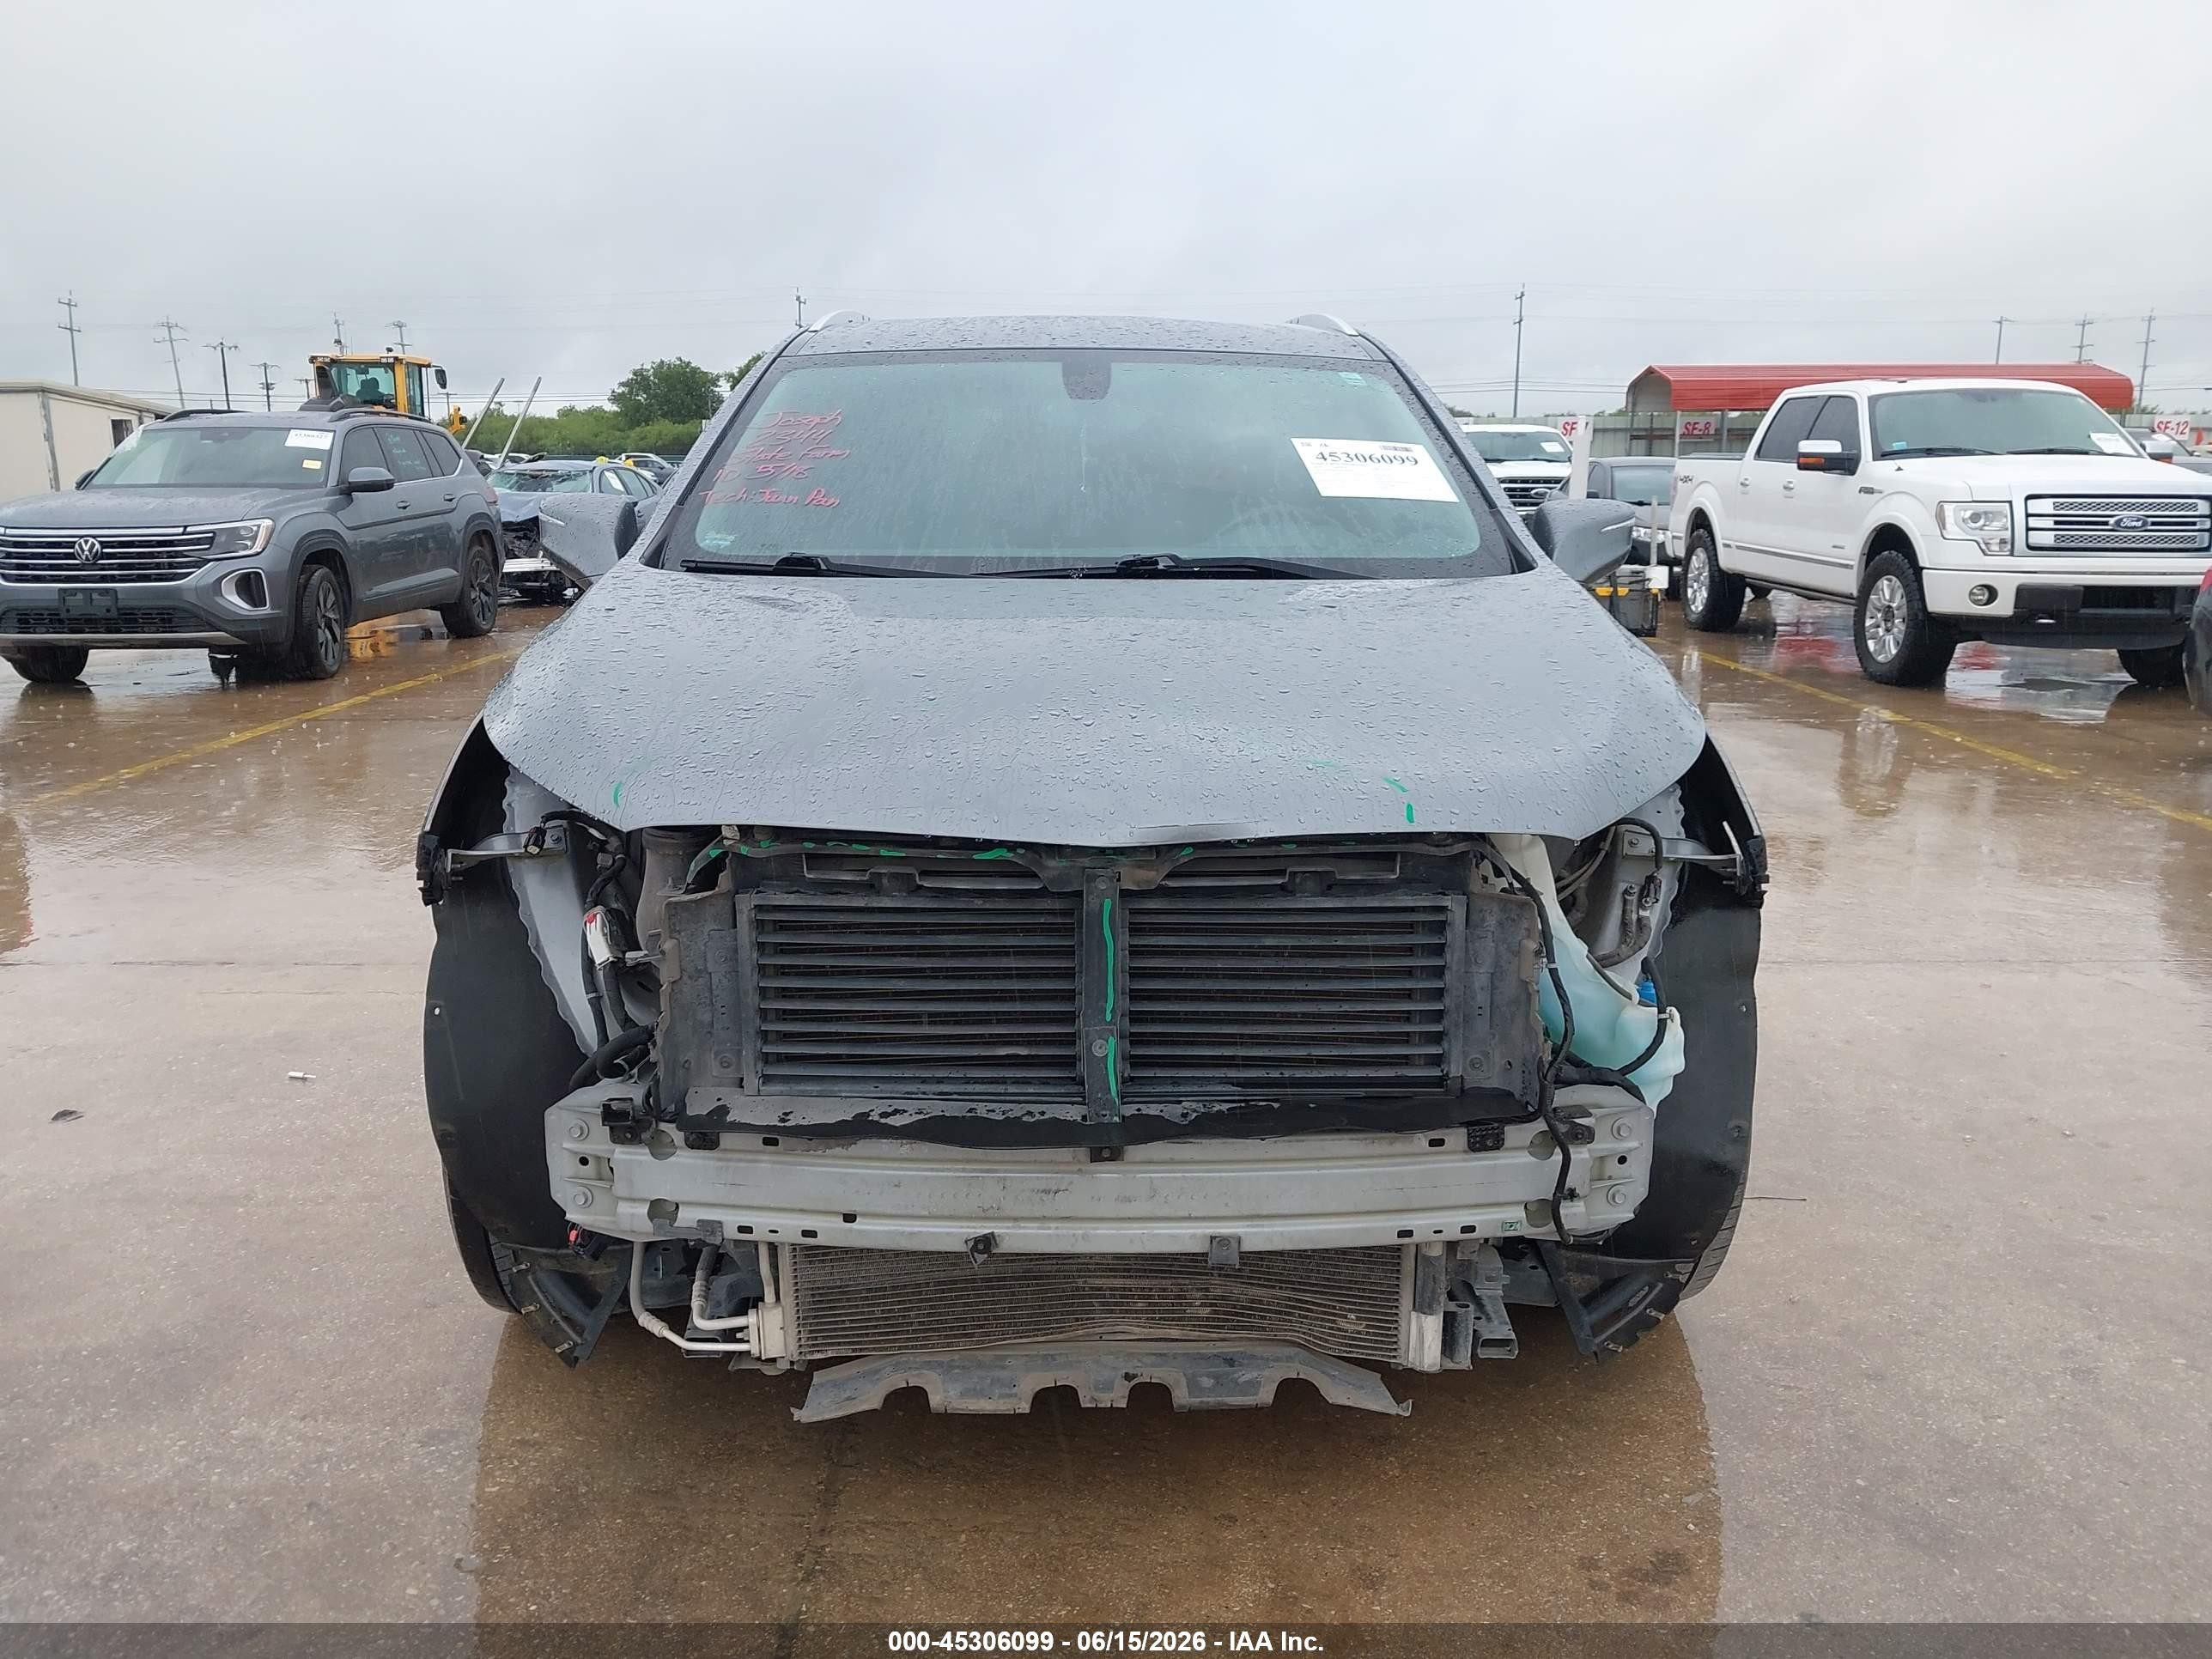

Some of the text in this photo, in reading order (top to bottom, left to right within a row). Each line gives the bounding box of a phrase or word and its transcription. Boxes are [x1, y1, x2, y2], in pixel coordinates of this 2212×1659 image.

[745, 409, 842, 431] Joseph
[1683, 421, 1711, 435] SF-8
[2156, 421, 2189, 435] SF-12
[730, 445, 851, 465] State Farm
[1316, 452, 1419, 466] 45306099
[2120, 517, 2143, 527] Ford
